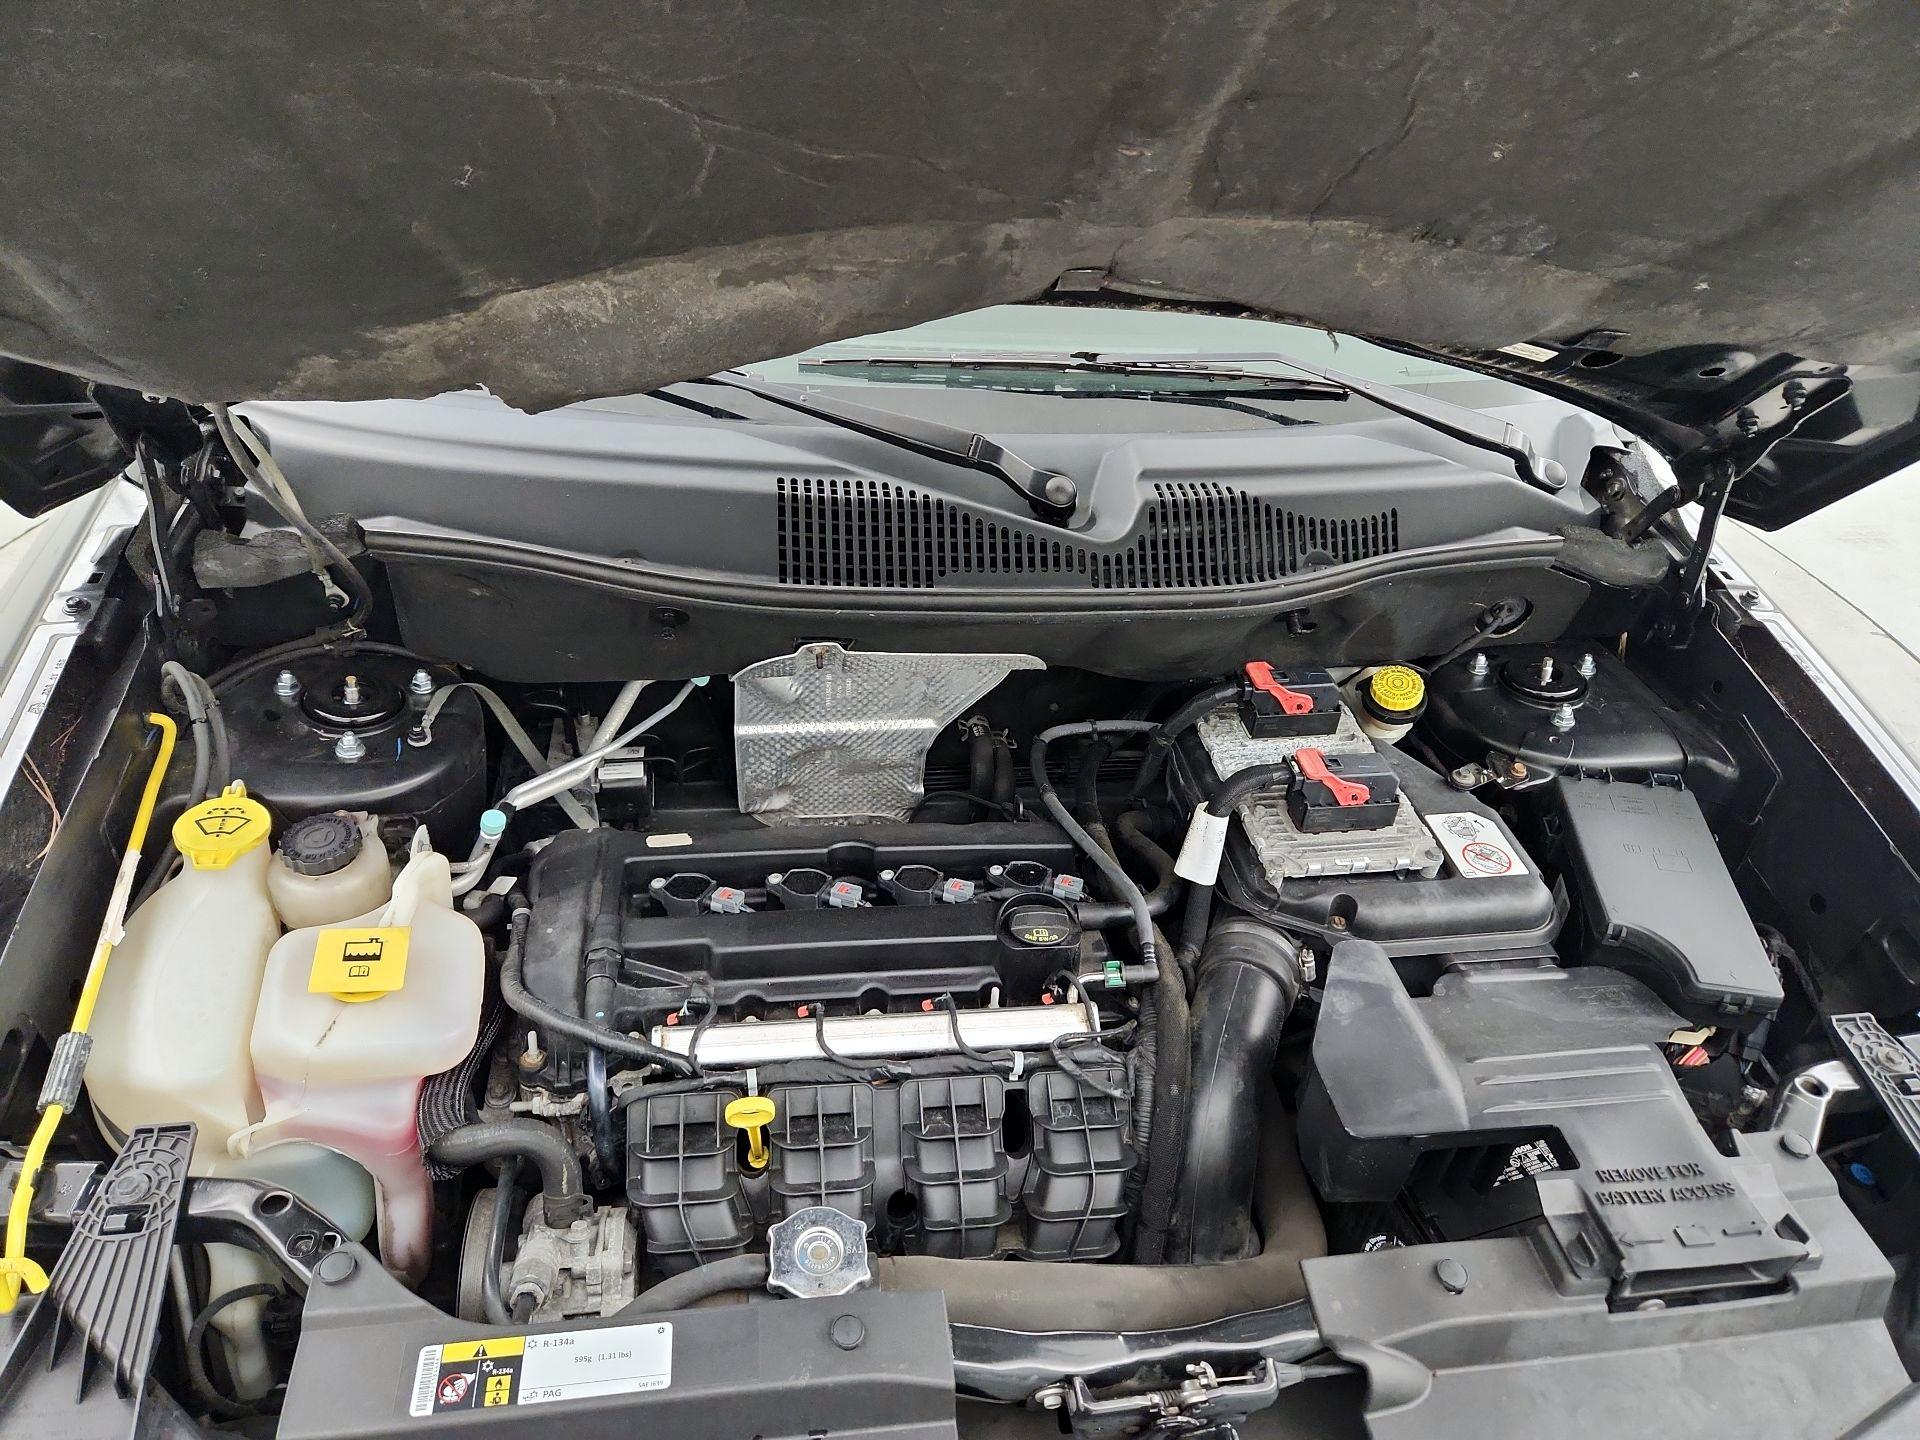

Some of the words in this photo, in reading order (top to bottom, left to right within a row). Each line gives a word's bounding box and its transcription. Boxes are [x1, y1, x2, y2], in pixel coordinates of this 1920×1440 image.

[1595, 1166, 1668, 1183] REMOVE
[1668, 1162, 1704, 1179] FOR
[1595, 1187, 1666, 1206] BATTERY
[1671, 1182, 1736, 1202] ACCESS
[543, 1337, 575, 1348] R-134a
[574, 1355, 593, 1364] 595g
[598, 1352, 617, 1362] (1.31
[618, 1350, 632, 1359] lbs)
[543, 1389, 562, 1398] PAG
